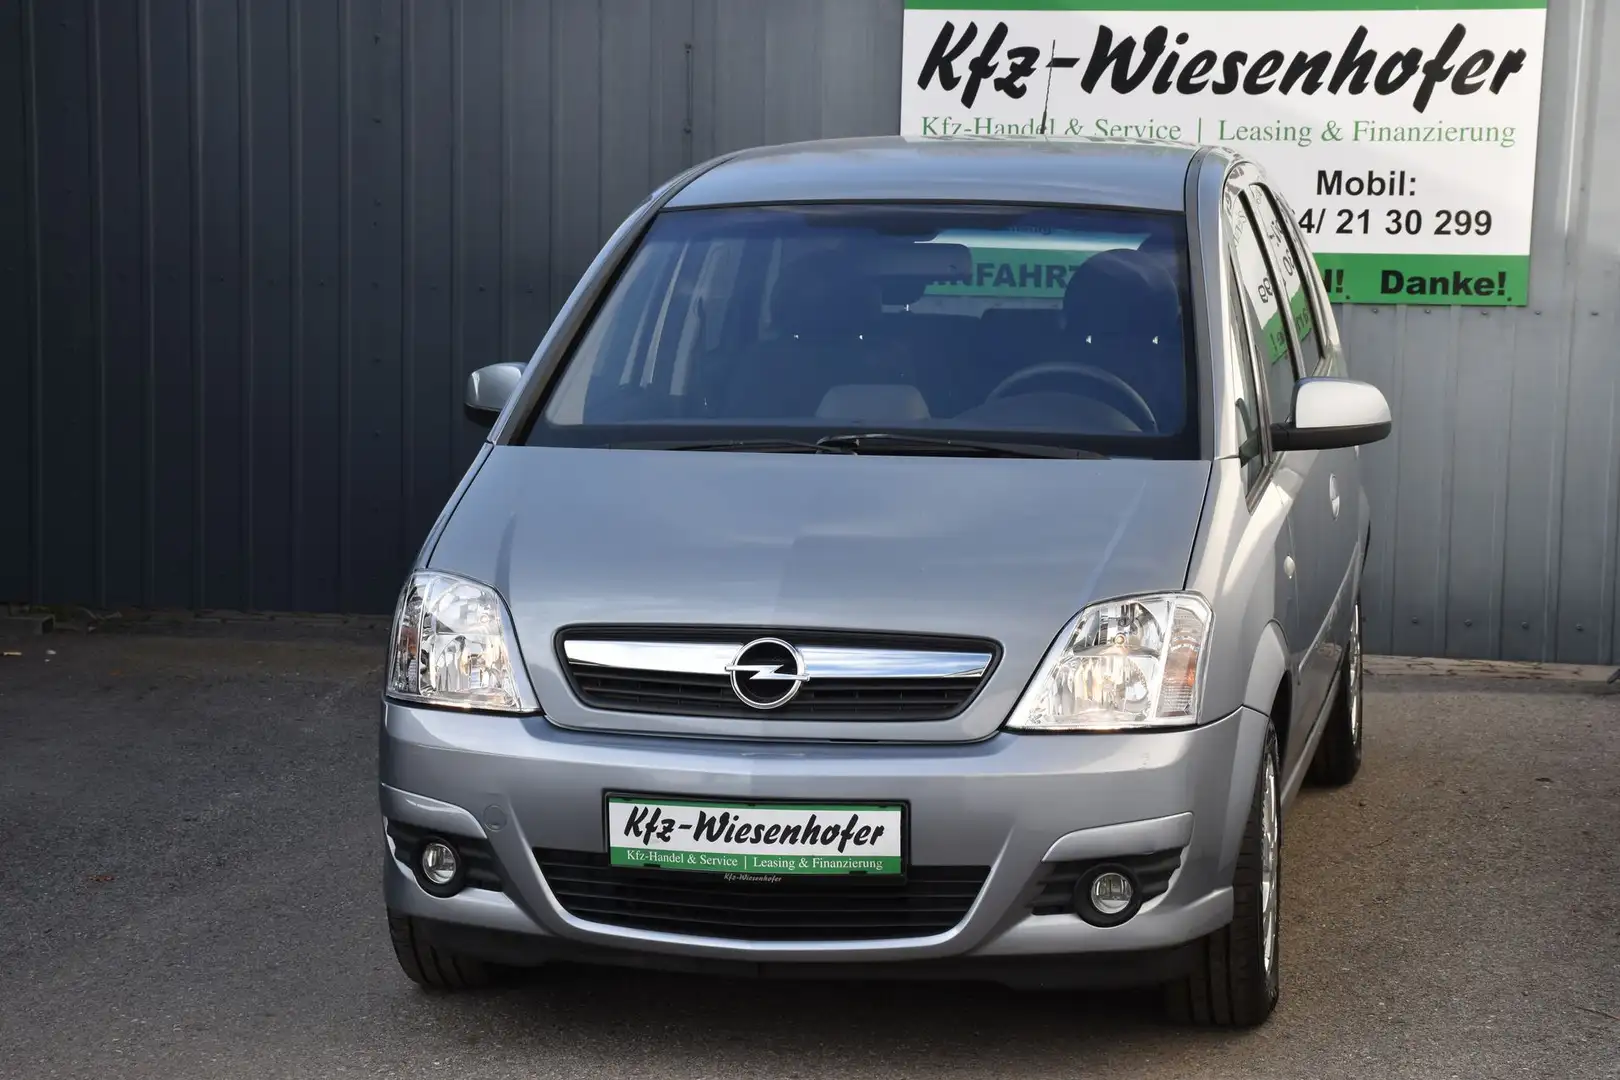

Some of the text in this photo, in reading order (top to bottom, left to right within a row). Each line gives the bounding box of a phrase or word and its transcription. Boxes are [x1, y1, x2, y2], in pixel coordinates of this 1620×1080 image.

[917, 20, 1527, 114] Kfz-Wiesenhofer
[1063, 118, 1085, 136] &
[1095, 118, 1181, 140] Service
[1218, 119, 1313, 148] Leasing
[1321, 120, 1344, 142] &
[1352, 120, 1516, 148] Finanzierung
[1316, 169, 1416, 197] Mobil:
[1335, 208, 1370, 235] 21
[1385, 209, 1423, 236] 30
[1433, 209, 1492, 236] 299
[1379, 269, 1507, 296] Danke!
[623, 806, 885, 854] Kfz-Wiesenhofer
[627, 850, 883, 870] Kfz-Handel & Service Leasing & Finanzierung
